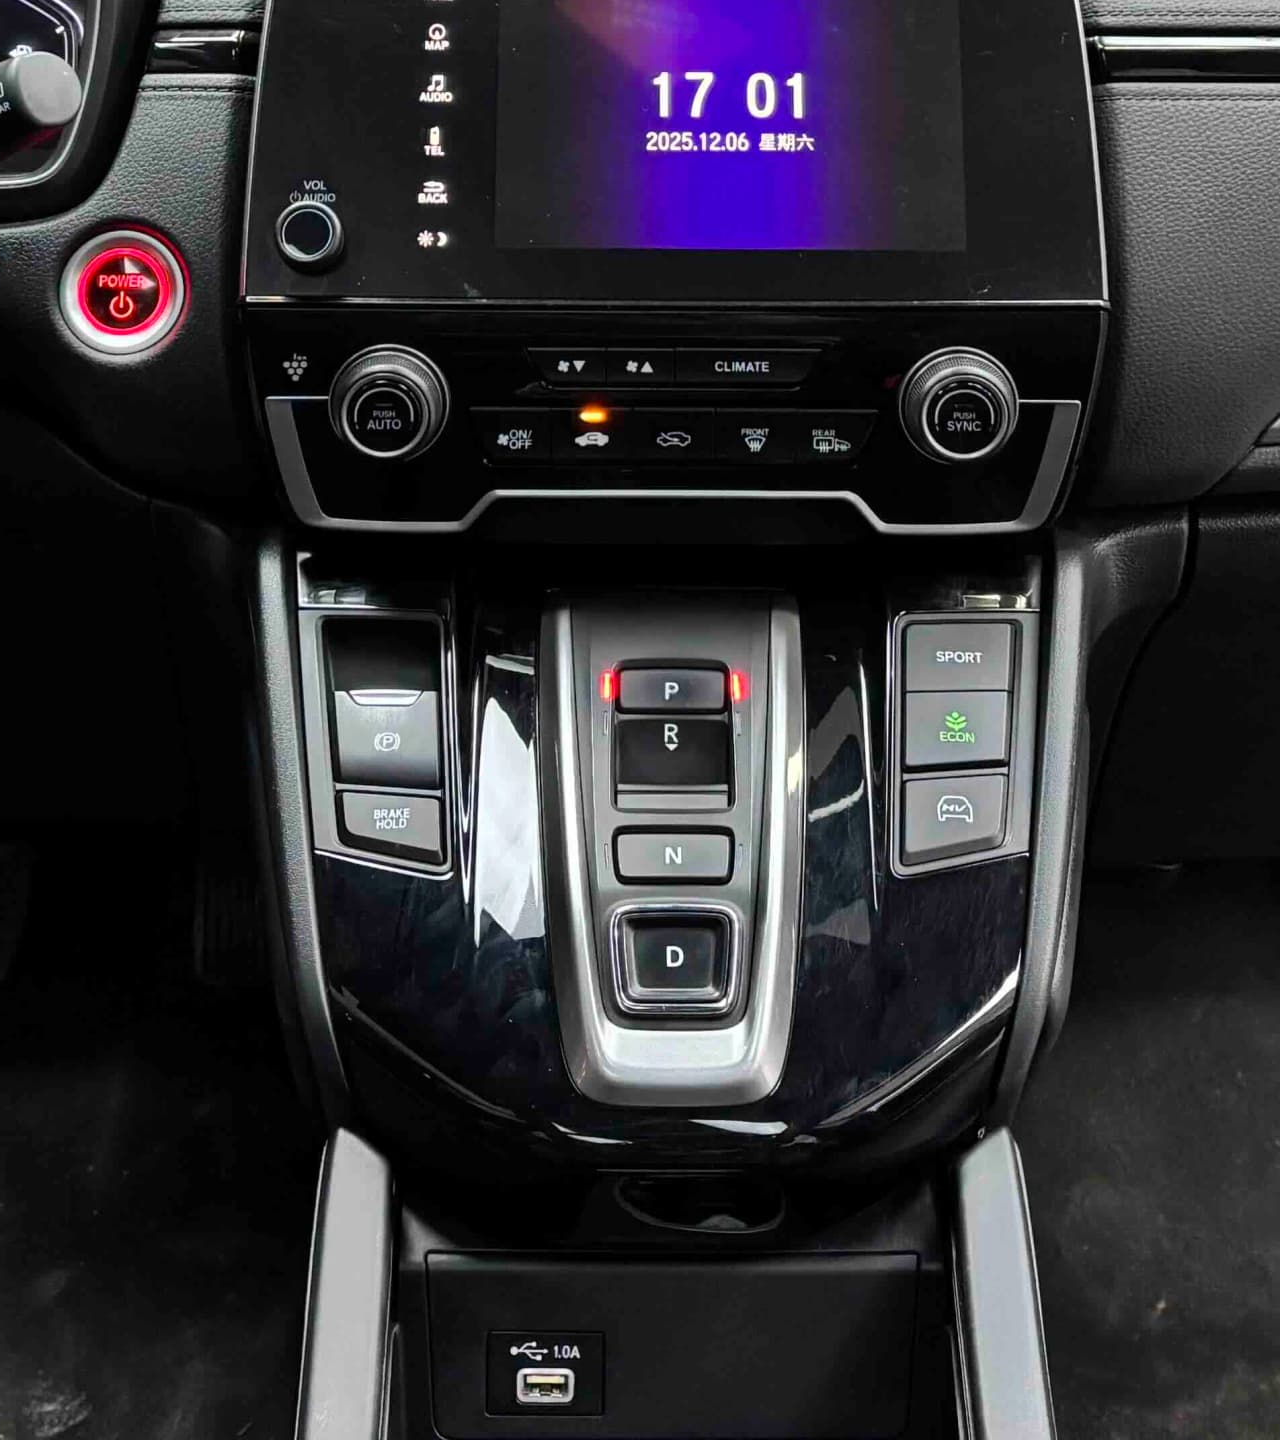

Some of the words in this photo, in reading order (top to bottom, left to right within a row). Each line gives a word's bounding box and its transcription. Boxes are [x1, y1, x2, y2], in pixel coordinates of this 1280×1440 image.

[424, 40, 450, 51] MAP
[419, 92, 453, 103] AUDIO
[652, 71, 714, 118] 17
[746, 72, 804, 119] 01
[646, 131, 749, 151] 2025.12.06
[758, 133, 815, 151] 星期六
[424, 145, 445, 156] TEL
[303, 180, 327, 191] VOL
[303, 192, 336, 203] AUDIO
[418, 193, 448, 204] BACK
[99, 274, 146, 289] POWER
[714, 361, 770, 373] CLIMATE
[372, 410, 396, 418] PUSH
[953, 411, 976, 419] PUSH
[367, 419, 402, 430] AUTO
[947, 421, 982, 432] SYNC
[740, 428, 769, 436] FRONT
[509, 439, 533, 449] OFF
[936, 651, 984, 664] SPORT
[664, 682, 680, 701] P
[663, 723, 679, 743] R
[939, 731, 976, 744] ECON
[373, 808, 411, 820] BRAKE
[376, 818, 407, 830] HOLD
[664, 846, 682, 865] N
[666, 945, 685, 968] D
[553, 1345, 581, 1359] 1.0A
